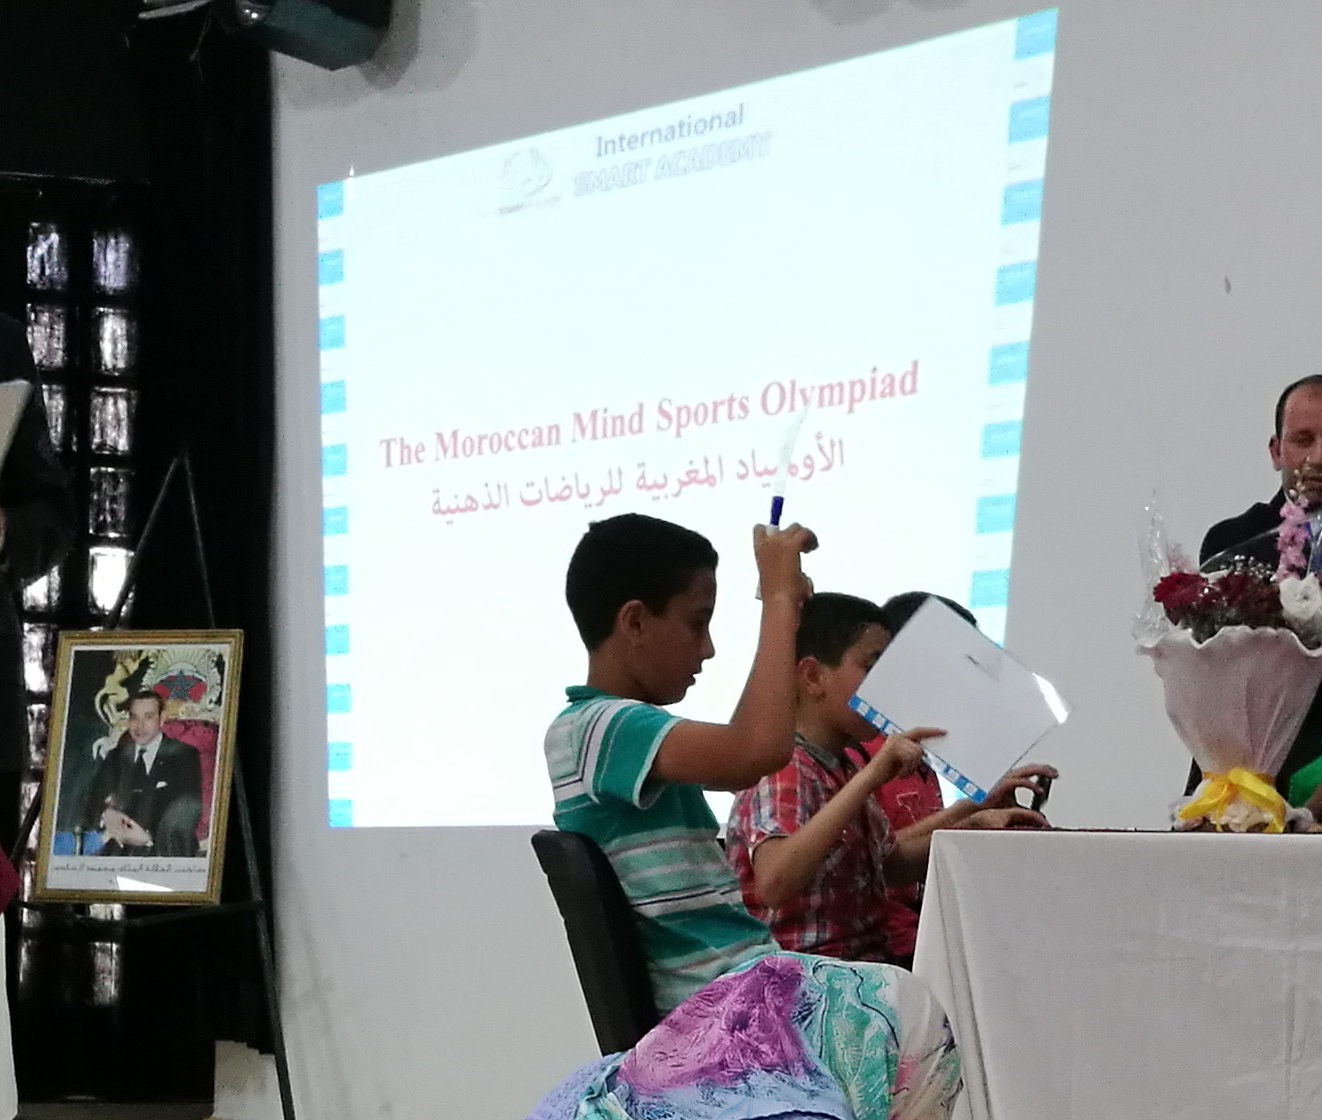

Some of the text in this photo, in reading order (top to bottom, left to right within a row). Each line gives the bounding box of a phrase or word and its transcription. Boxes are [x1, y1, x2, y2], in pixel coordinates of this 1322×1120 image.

[596, 103, 745, 157] International
[379, 360, 919, 468] The Moroccan Mind Sports Olympiad
[520, 466, 622, 509] للرياضات
[636, 454, 724, 501] المغربية
[431, 481, 509, 525] الذهنية
